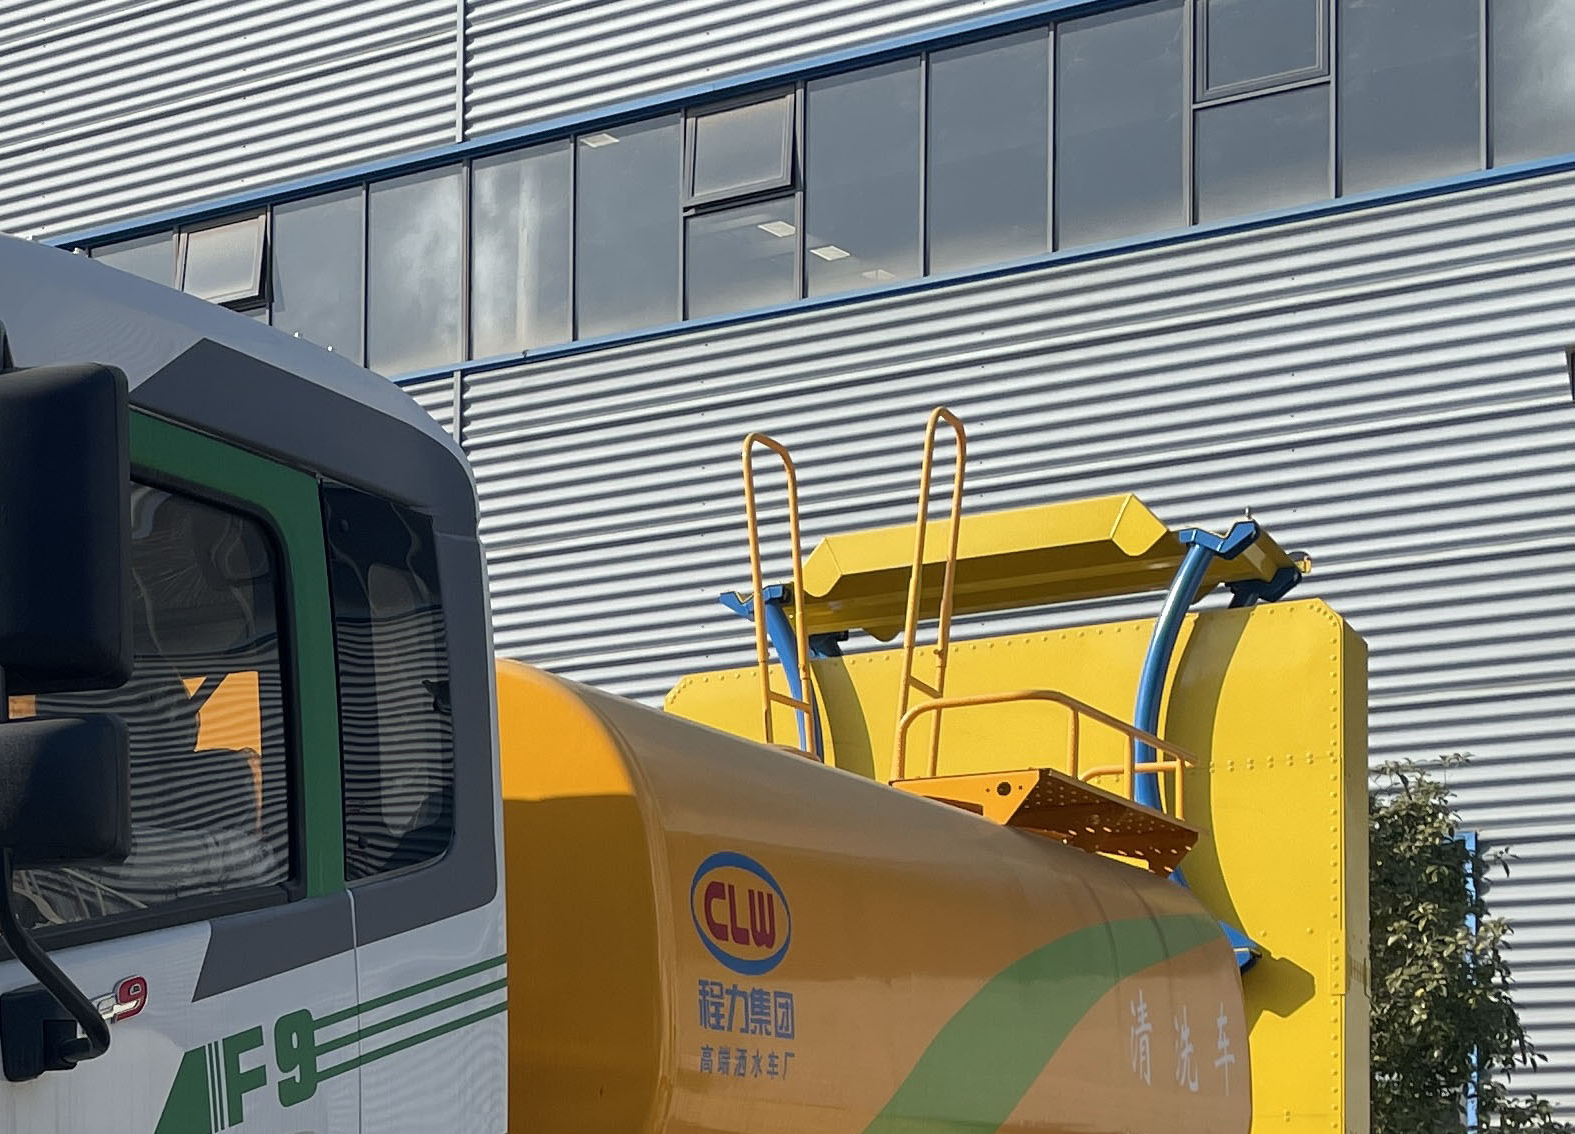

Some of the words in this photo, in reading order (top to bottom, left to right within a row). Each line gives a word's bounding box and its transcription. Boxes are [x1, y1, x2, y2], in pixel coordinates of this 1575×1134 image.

[703, 880, 776, 949] CLW
[697, 979, 795, 1040] 程力集团
[222, 1008, 319, 1128] F9
